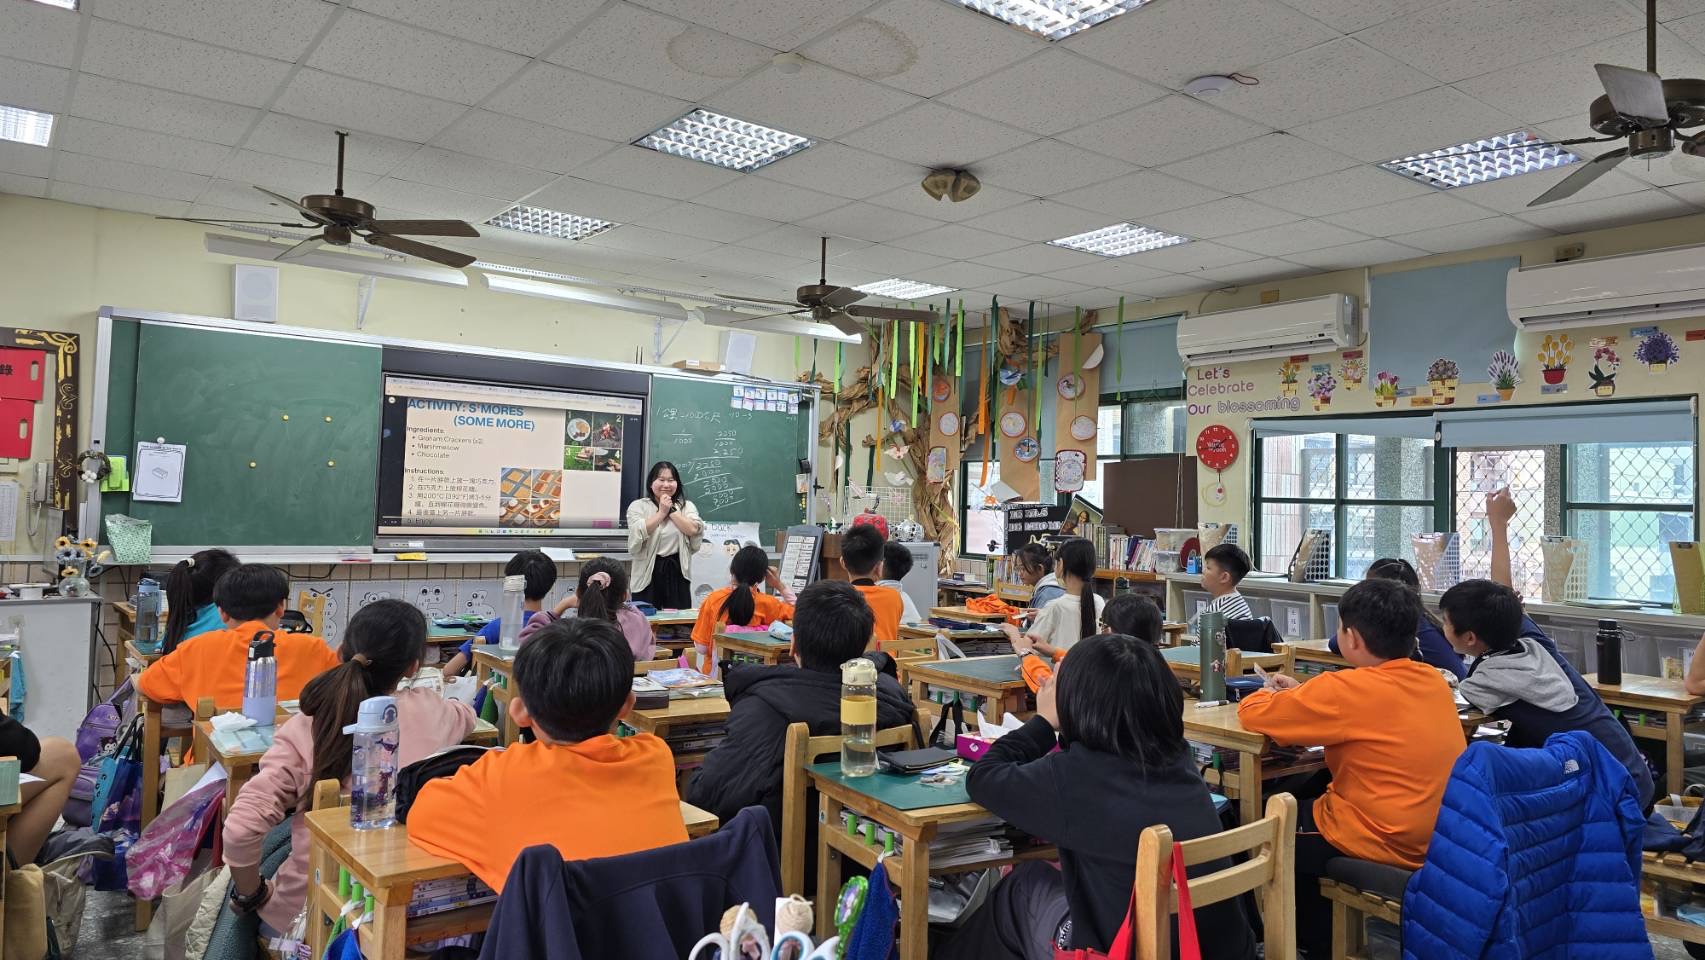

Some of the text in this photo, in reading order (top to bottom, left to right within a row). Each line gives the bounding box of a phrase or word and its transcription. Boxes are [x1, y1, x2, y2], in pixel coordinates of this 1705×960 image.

[1197, 367, 1231, 381] Let's
[1188, 380, 1255, 397] Celebrate
[407, 398, 524, 417] ACTIVITY: S'MORES
[1188, 396, 1300, 416] Our blossoming
[453, 415, 535, 432] (SOME MORE)
